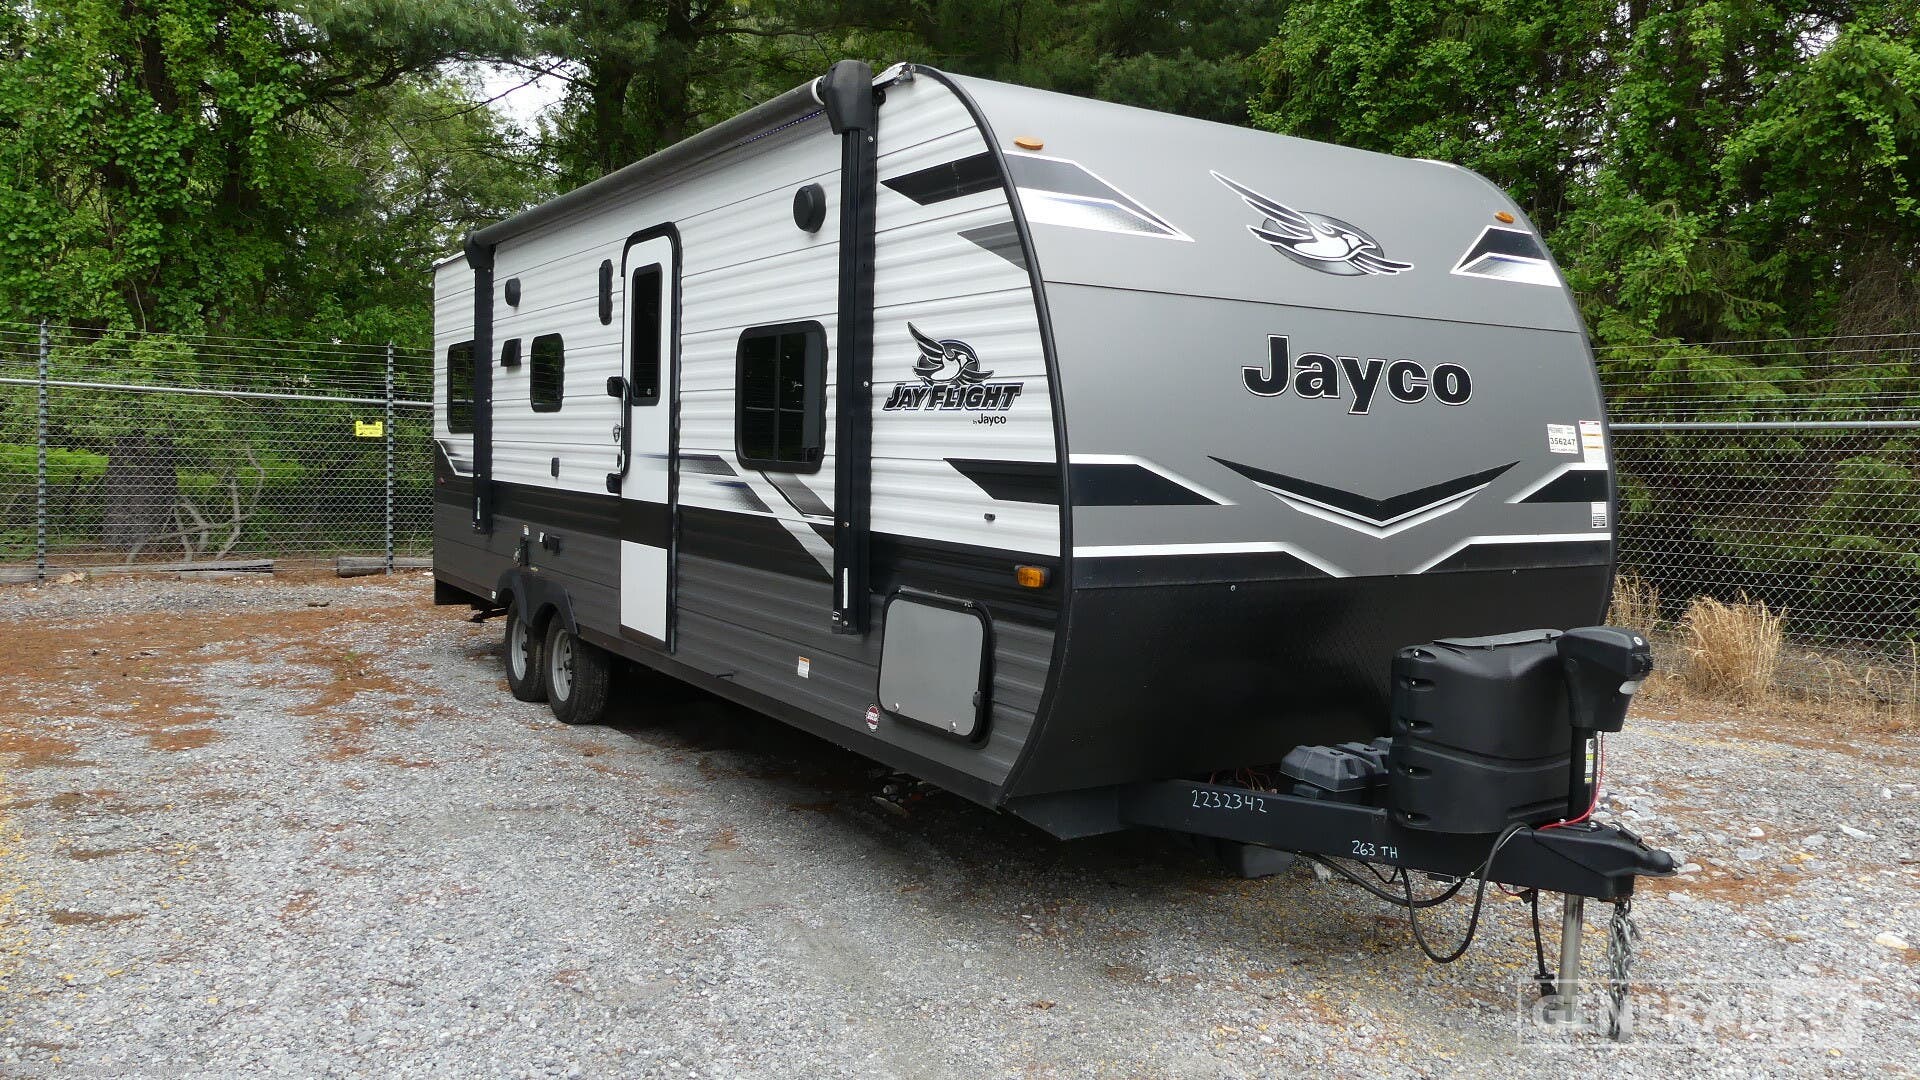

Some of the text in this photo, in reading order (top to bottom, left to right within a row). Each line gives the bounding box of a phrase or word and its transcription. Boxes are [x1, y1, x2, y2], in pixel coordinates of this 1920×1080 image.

[1241, 334, 1473, 415] Jayco
[978, 413, 1007, 426] Jayco
[1549, 437, 1576, 446] 356247
[1191, 789, 1267, 813] 2232342
[1351, 839, 1398, 858] 263 TH
